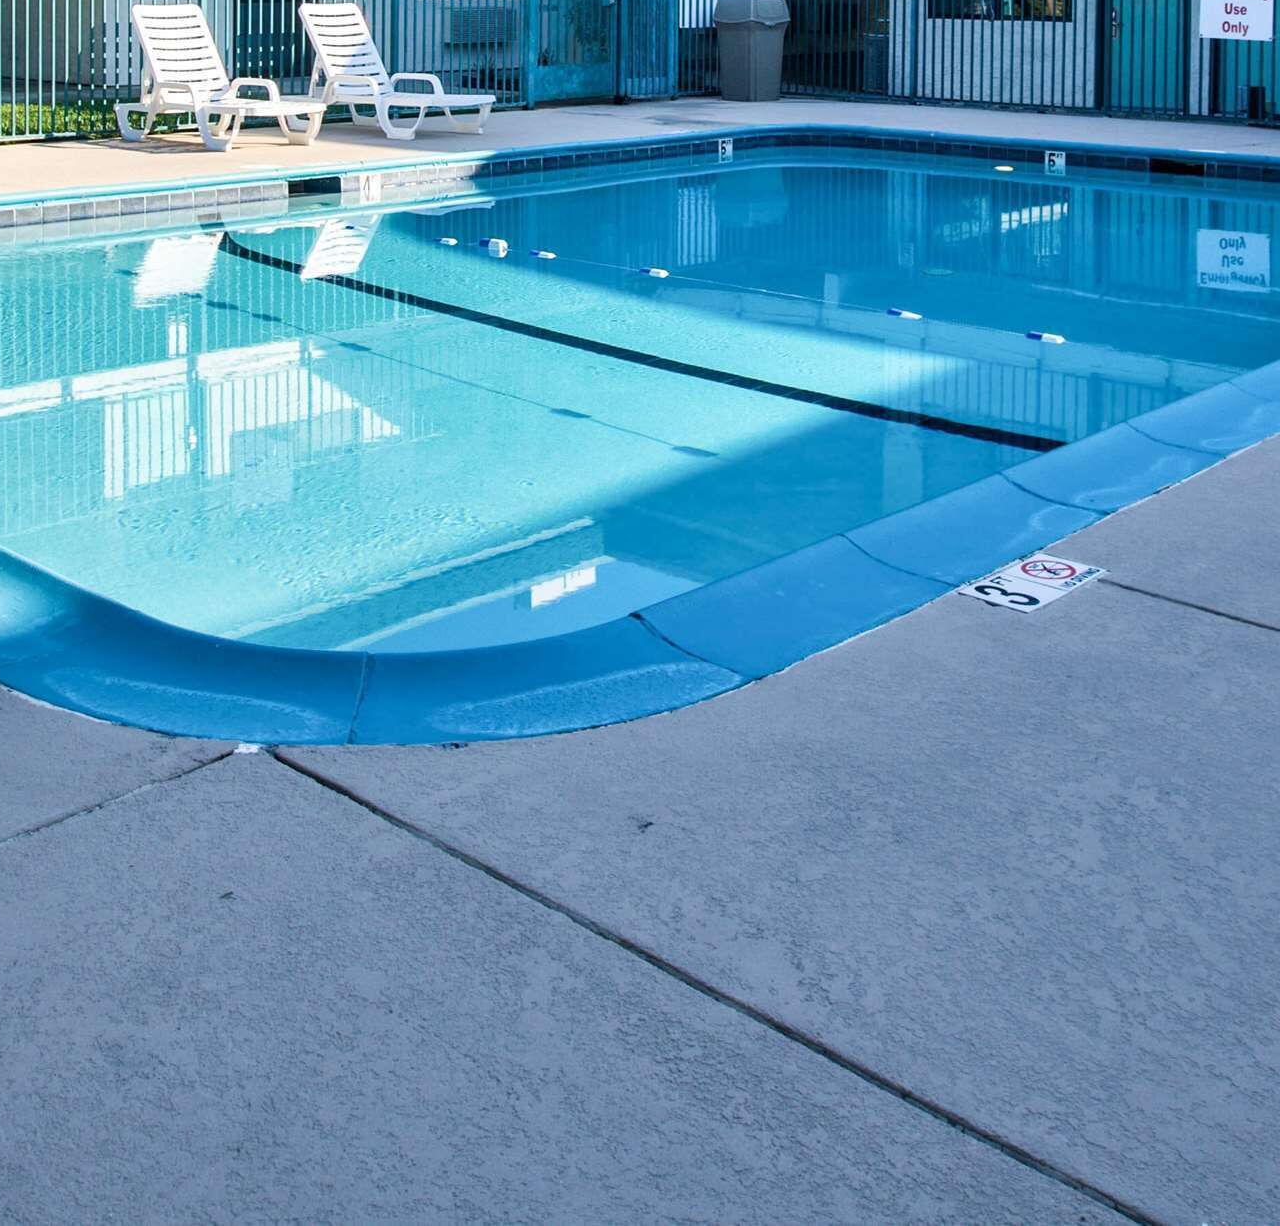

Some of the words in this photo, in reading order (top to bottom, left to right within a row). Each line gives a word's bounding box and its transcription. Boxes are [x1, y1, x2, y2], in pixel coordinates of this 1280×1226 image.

[1224, 3, 1248, 15] Use
[1222, 20, 1249, 37] Only
[990, 575, 1013, 586] FT
[974, 584, 1041, 607] 3
